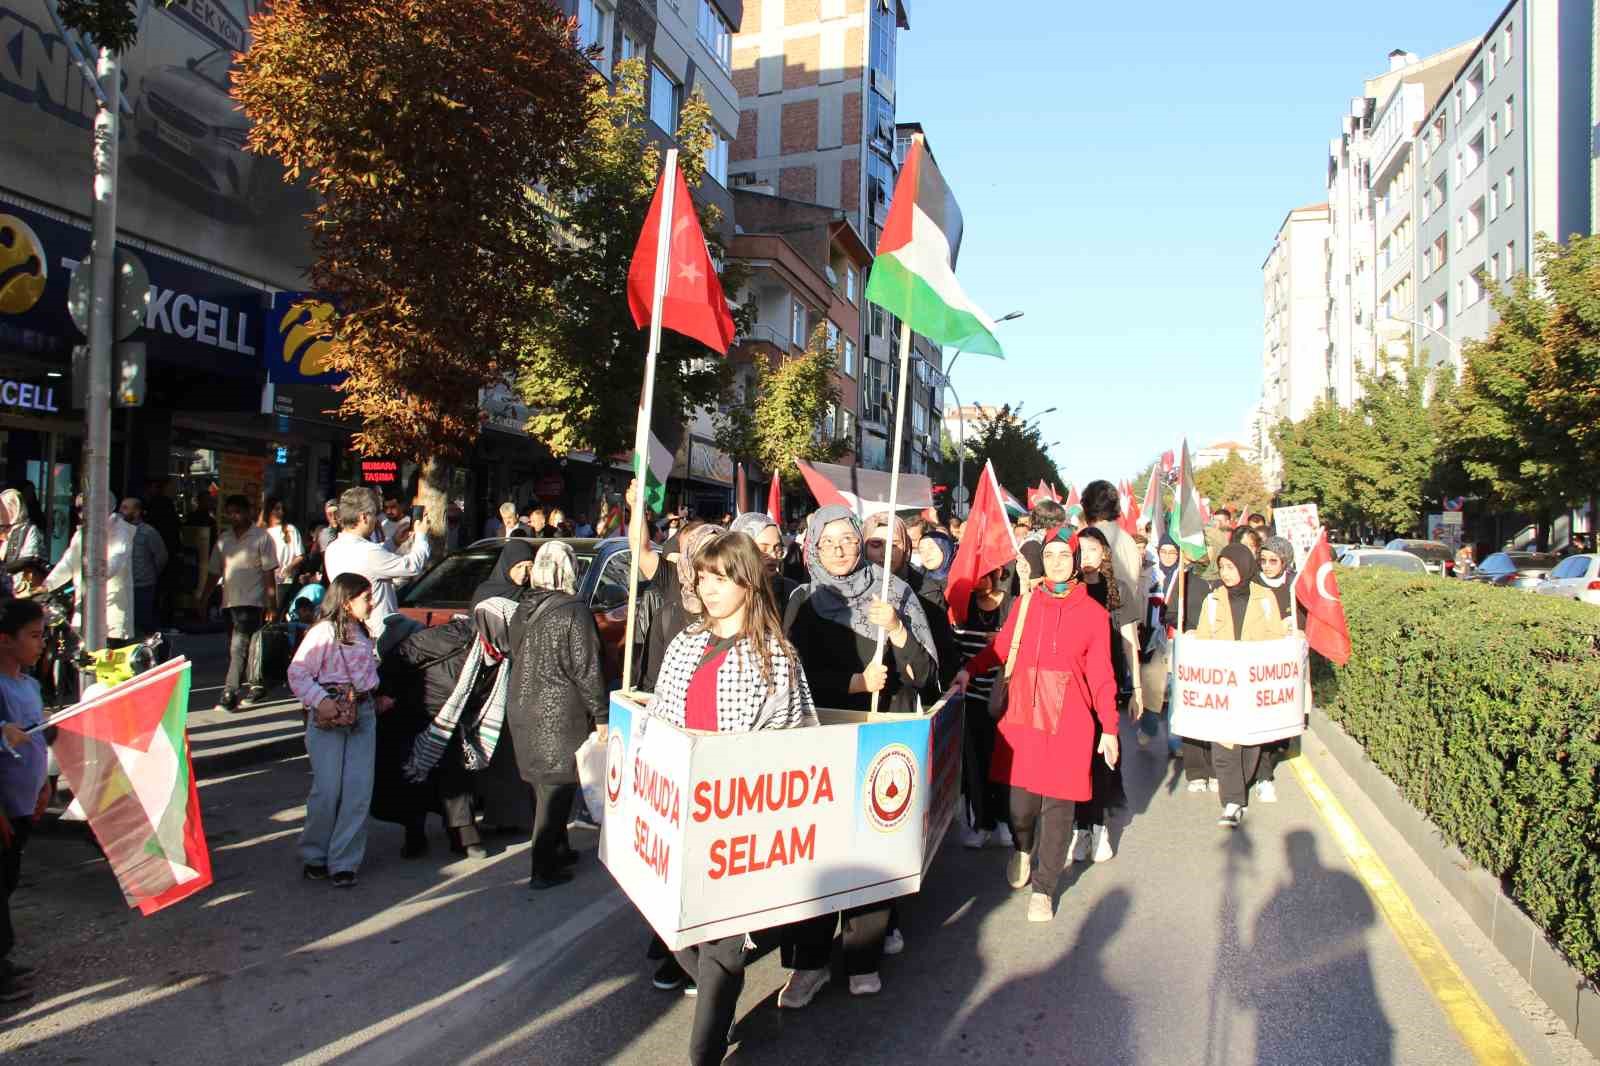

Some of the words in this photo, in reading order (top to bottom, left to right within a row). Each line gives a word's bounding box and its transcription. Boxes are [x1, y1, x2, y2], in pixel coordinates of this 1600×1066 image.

[0, 383, 59, 413] CELL
[1178, 664, 1238, 687] SUMUD'A
[1249, 661, 1299, 683] SUMUD'A
[1182, 689, 1230, 711] SELAM
[1255, 686, 1295, 707] SELAM
[633, 755, 681, 831] SUMUD'A
[692, 764, 835, 823] SUMUD'A
[633, 814, 671, 885] SELAM
[707, 823, 817, 880] SELAM
